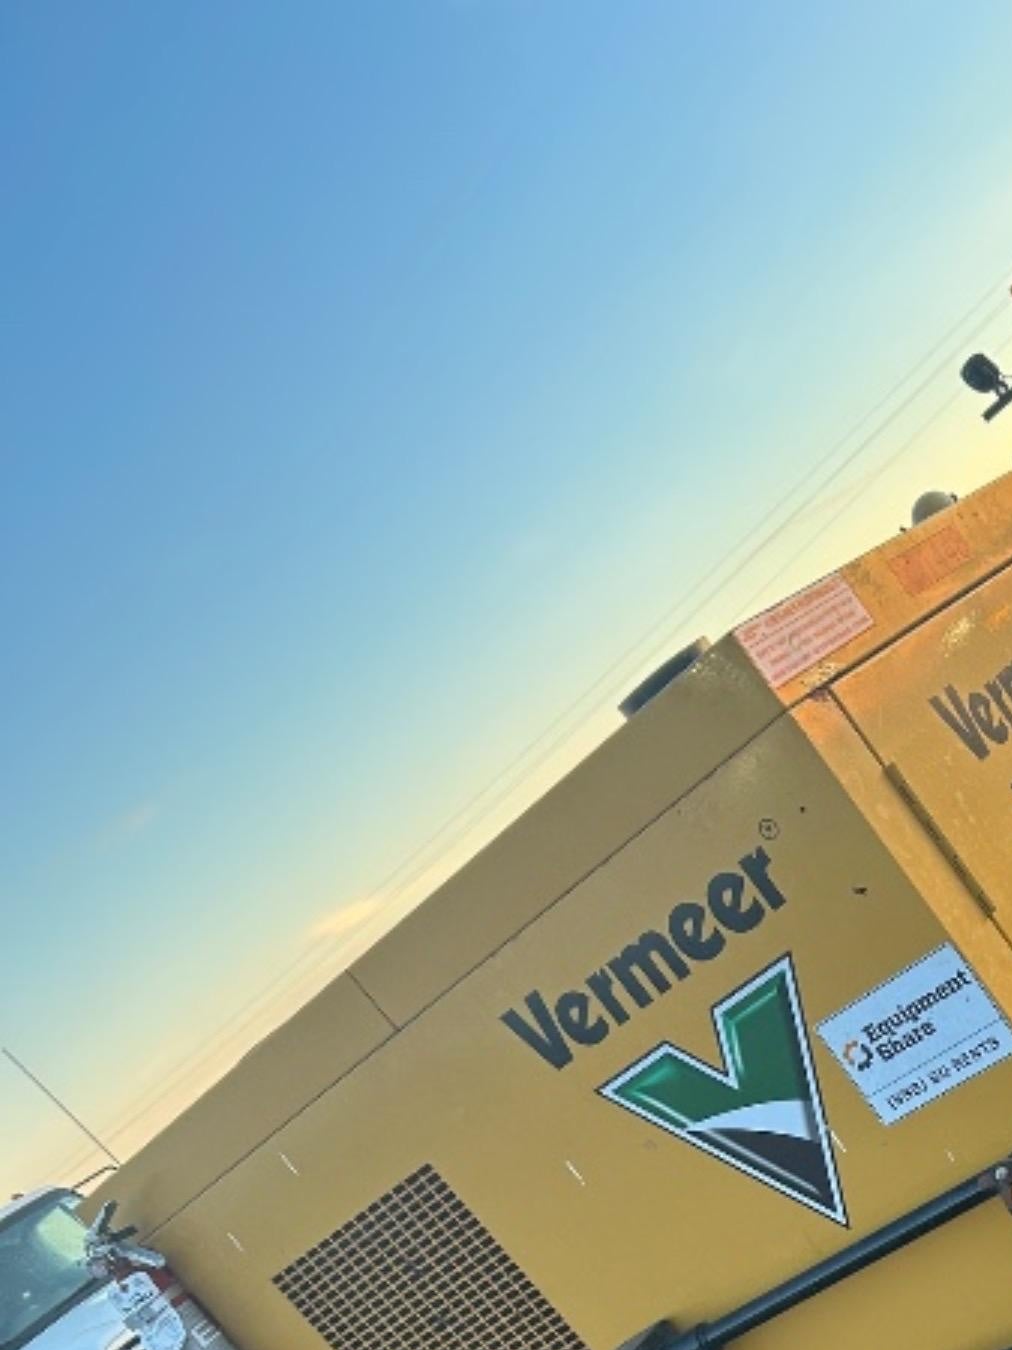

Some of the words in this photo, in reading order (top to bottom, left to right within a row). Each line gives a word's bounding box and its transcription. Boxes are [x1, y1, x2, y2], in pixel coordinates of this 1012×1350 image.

[498, 846, 787, 1071] Vermeer
[861, 969, 973, 1045] Equipment
[875, 1021, 937, 1063] Share
